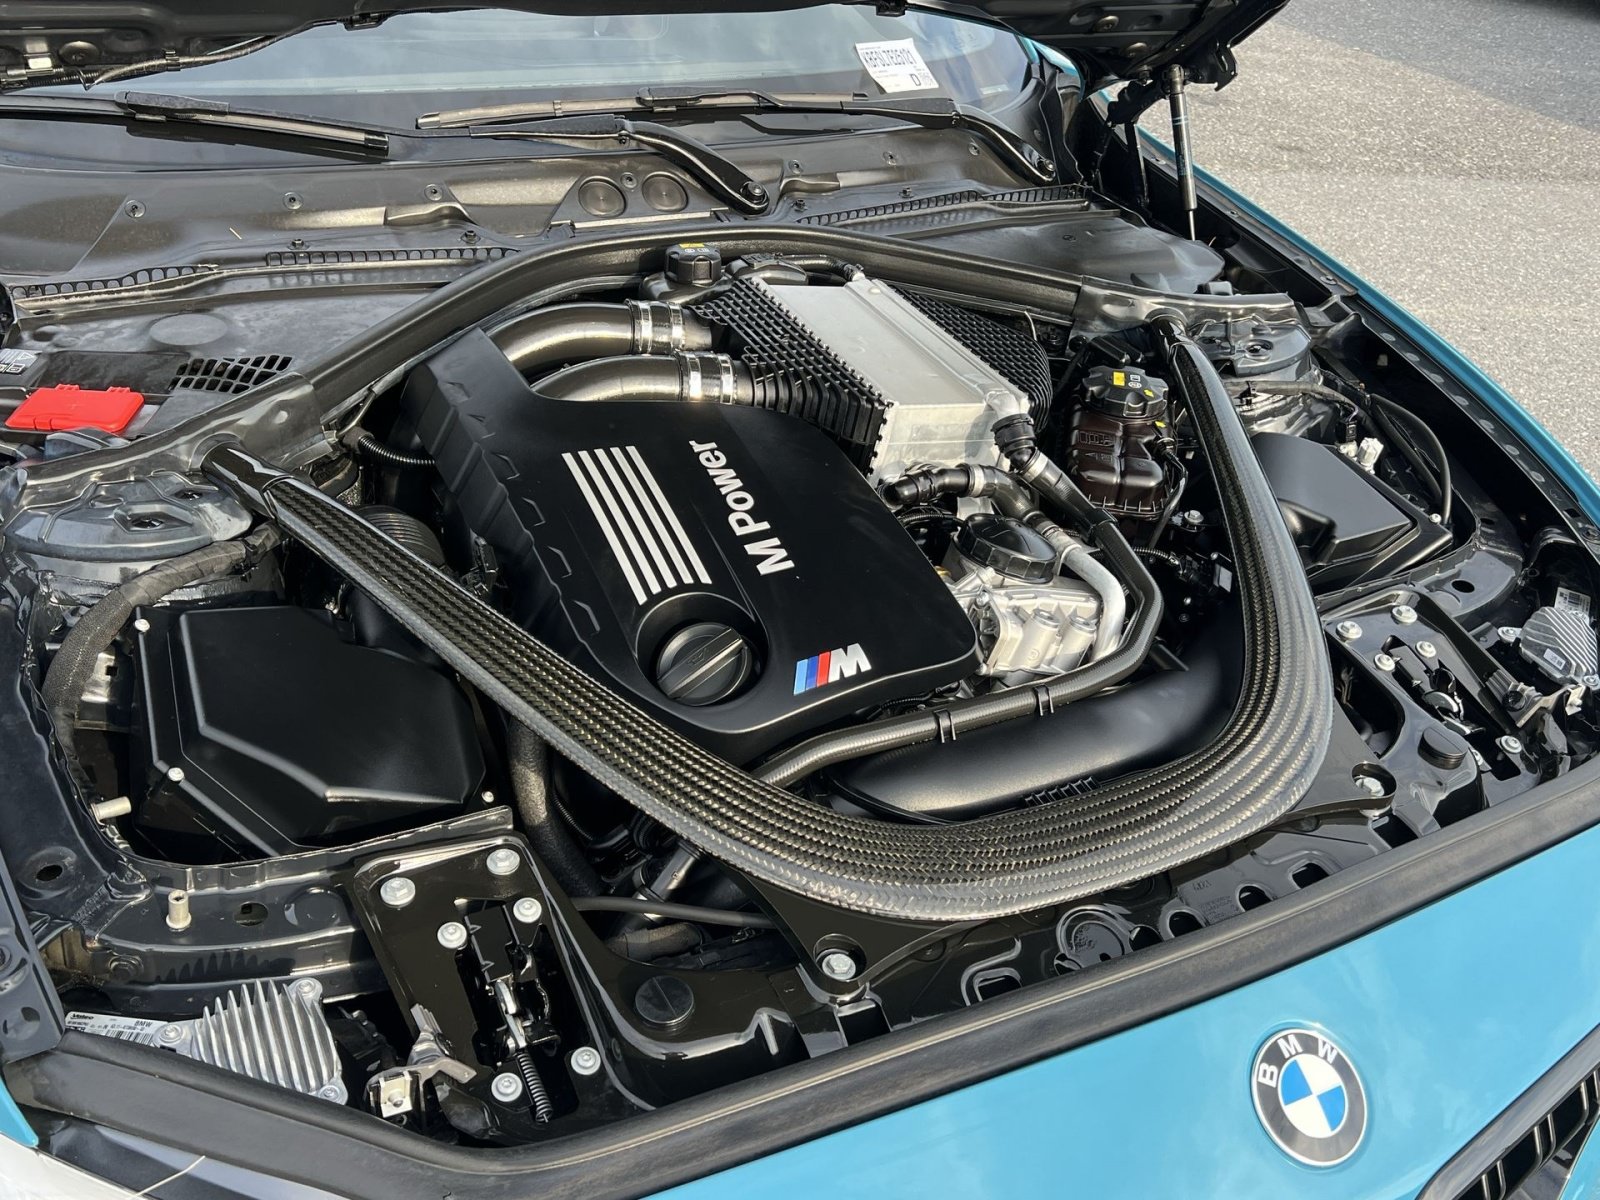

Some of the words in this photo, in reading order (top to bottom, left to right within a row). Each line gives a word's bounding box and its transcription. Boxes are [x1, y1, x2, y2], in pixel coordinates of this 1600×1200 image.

[910, 74, 921, 87] D
[688, 440, 771, 536] Power
[743, 537, 795, 576] M
[1258, 1034, 1338, 1088] BMW
